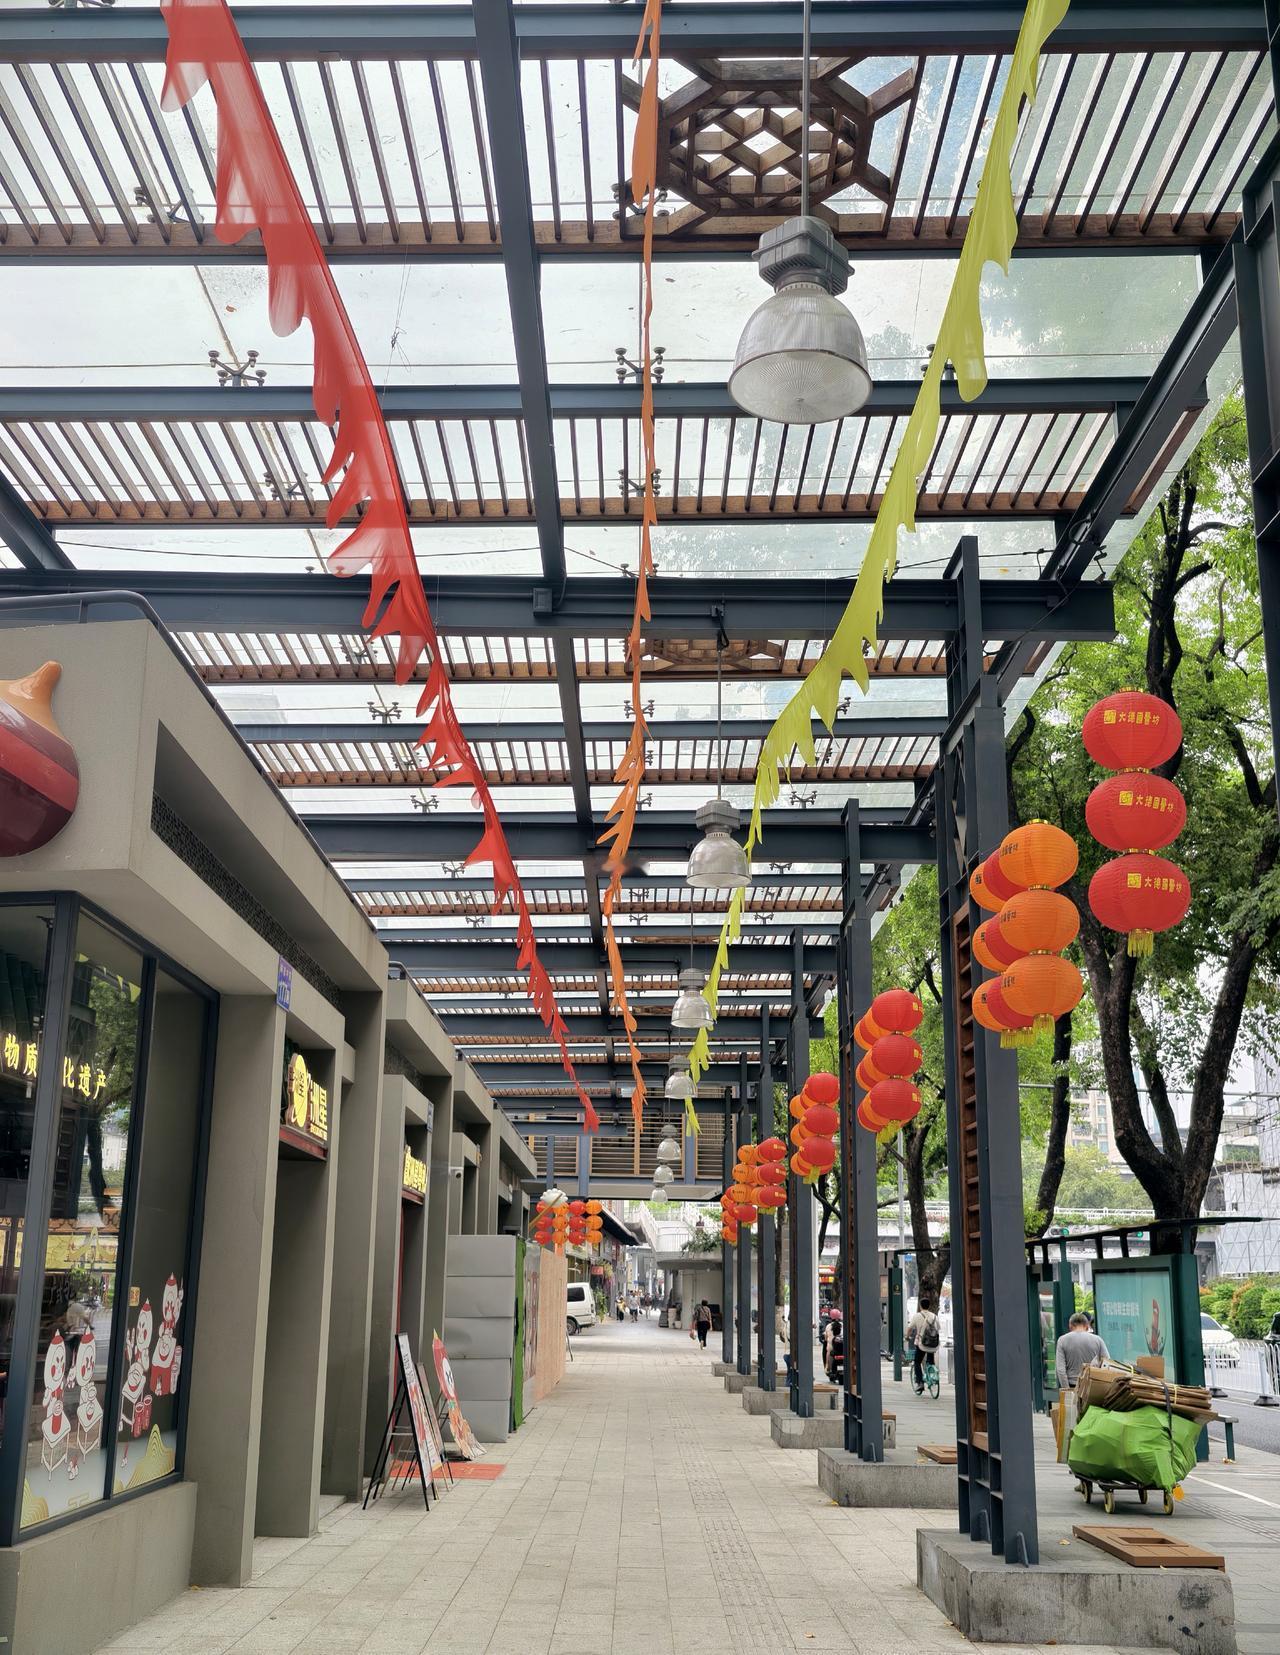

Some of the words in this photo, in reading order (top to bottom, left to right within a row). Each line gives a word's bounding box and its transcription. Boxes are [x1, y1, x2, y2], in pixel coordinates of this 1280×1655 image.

[4, 1033, 107, 1100] 物质化遗产
